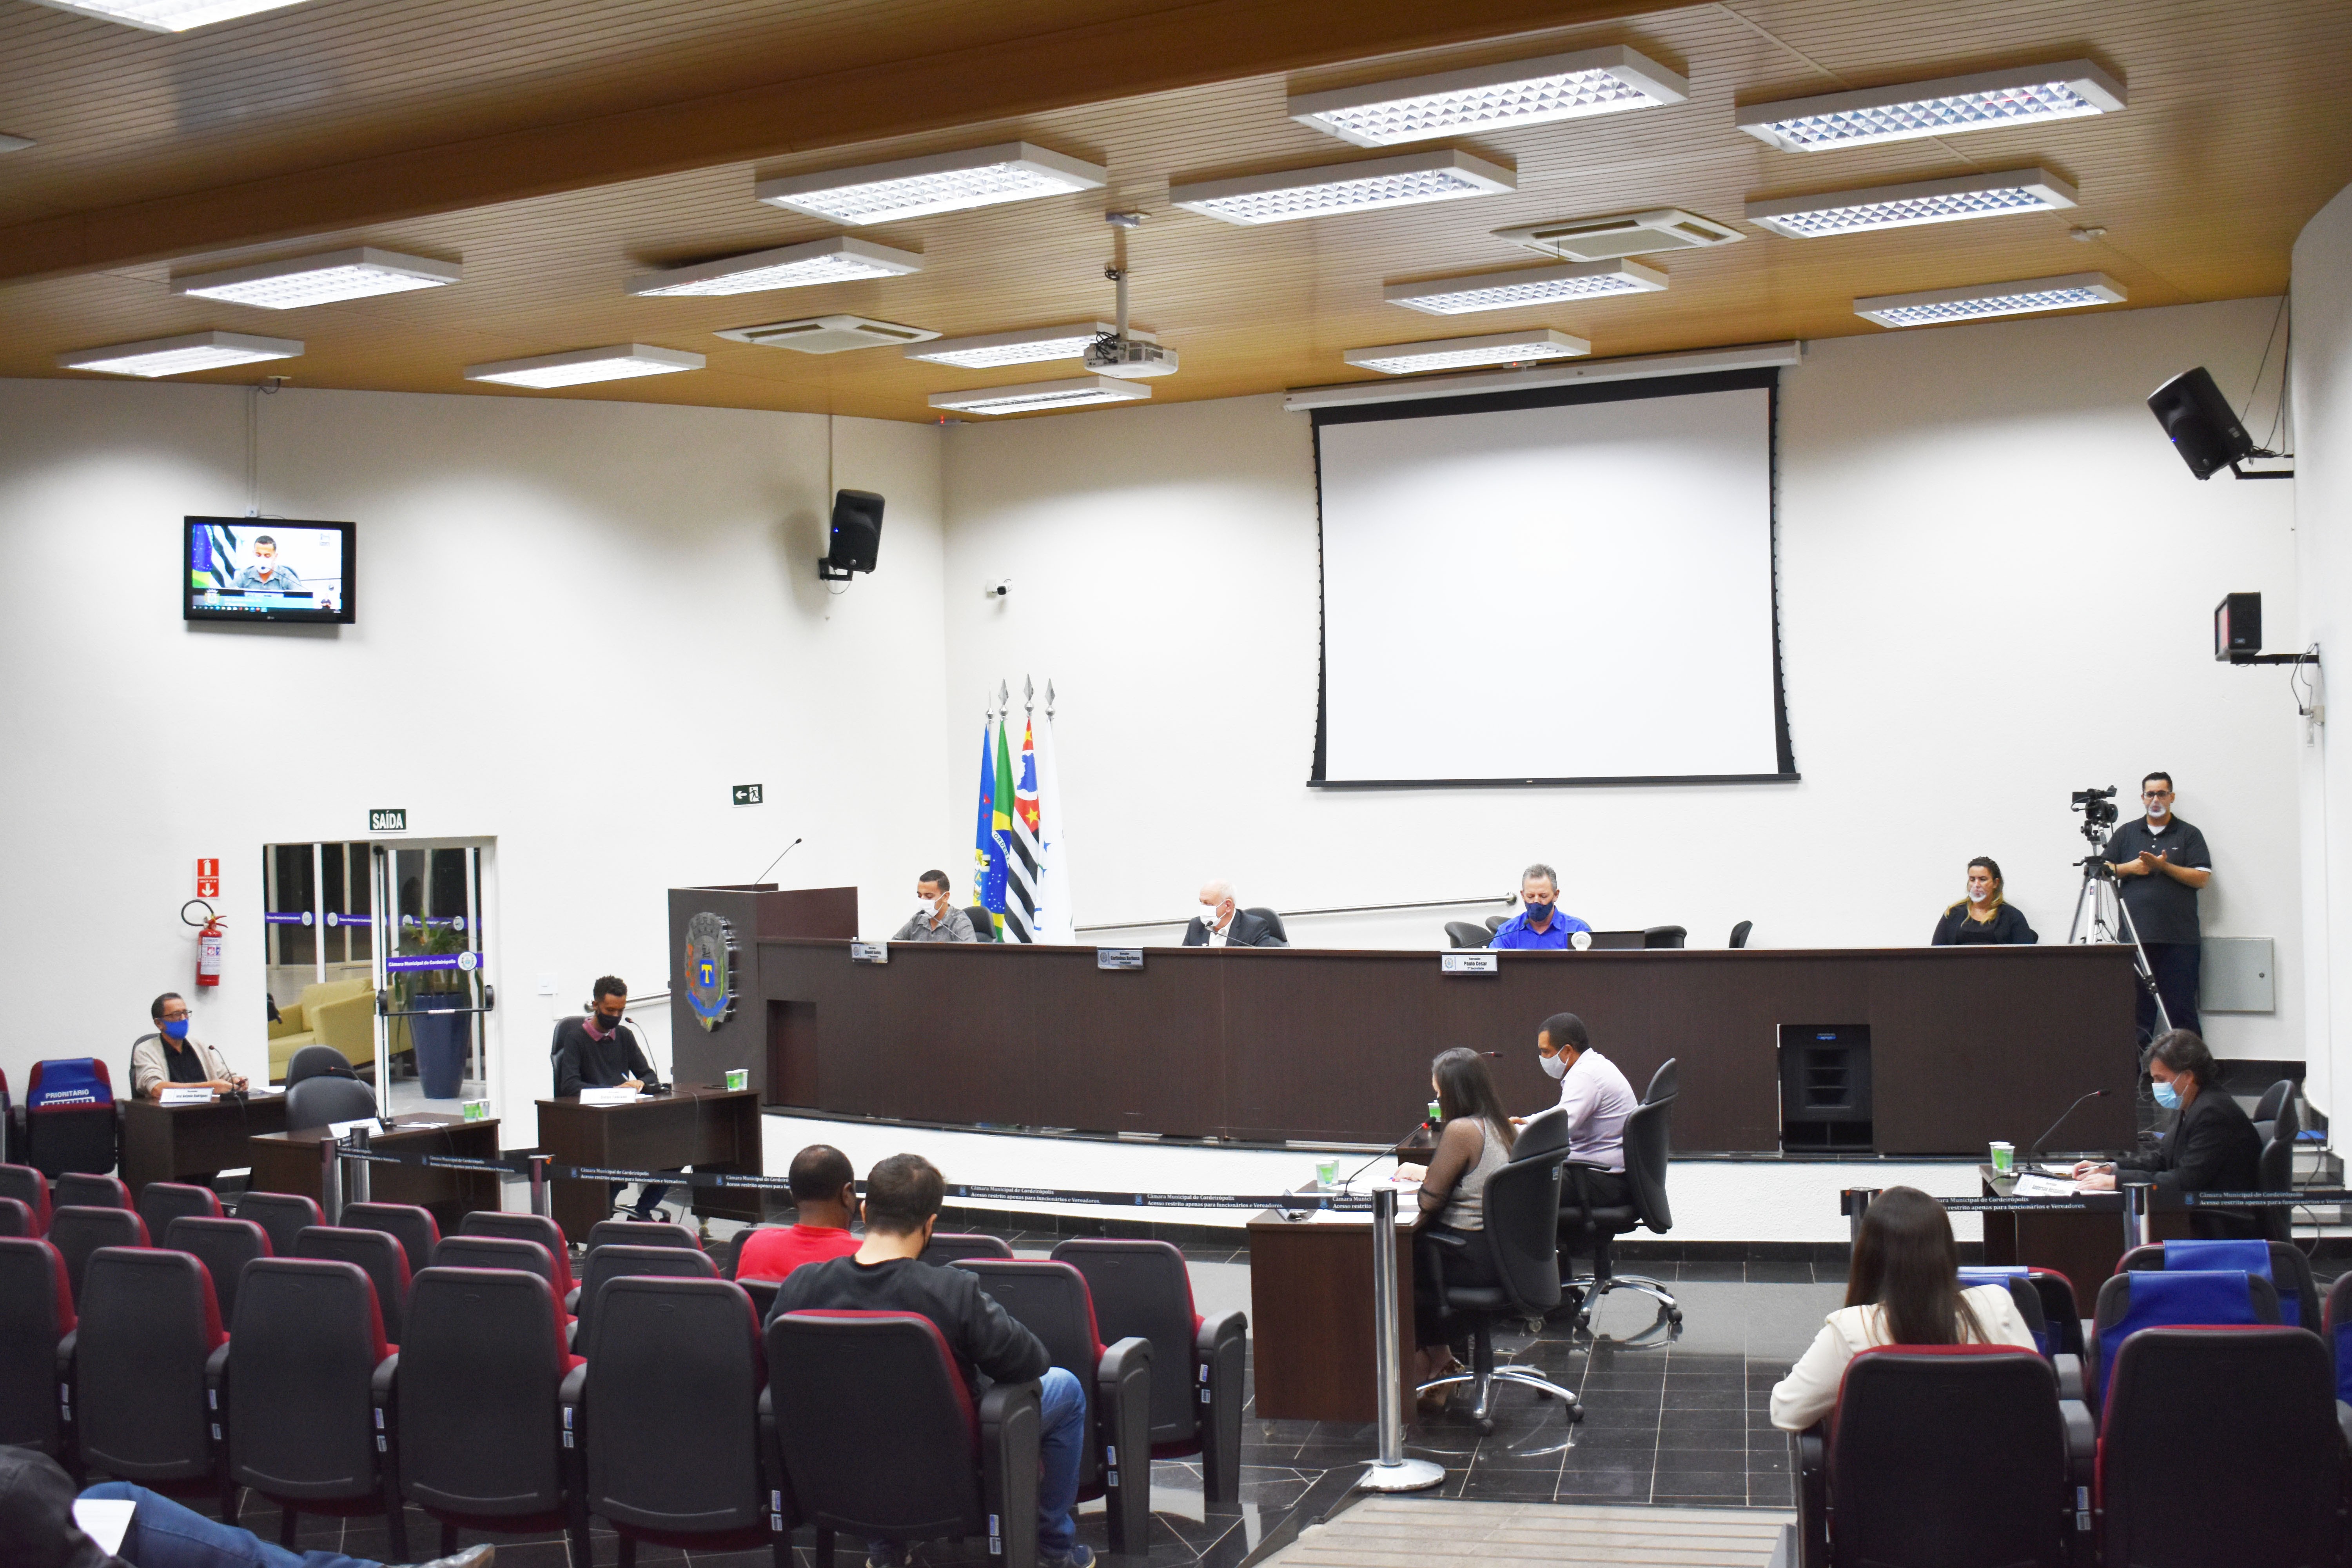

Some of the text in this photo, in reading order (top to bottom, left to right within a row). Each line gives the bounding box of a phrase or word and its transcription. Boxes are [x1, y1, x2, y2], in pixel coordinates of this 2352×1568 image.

[373, 810, 403, 829] SAÍDA
[994, 833, 1008, 856] ORDEM
[45, 1089, 89, 1099] PRIORITÁRIO
